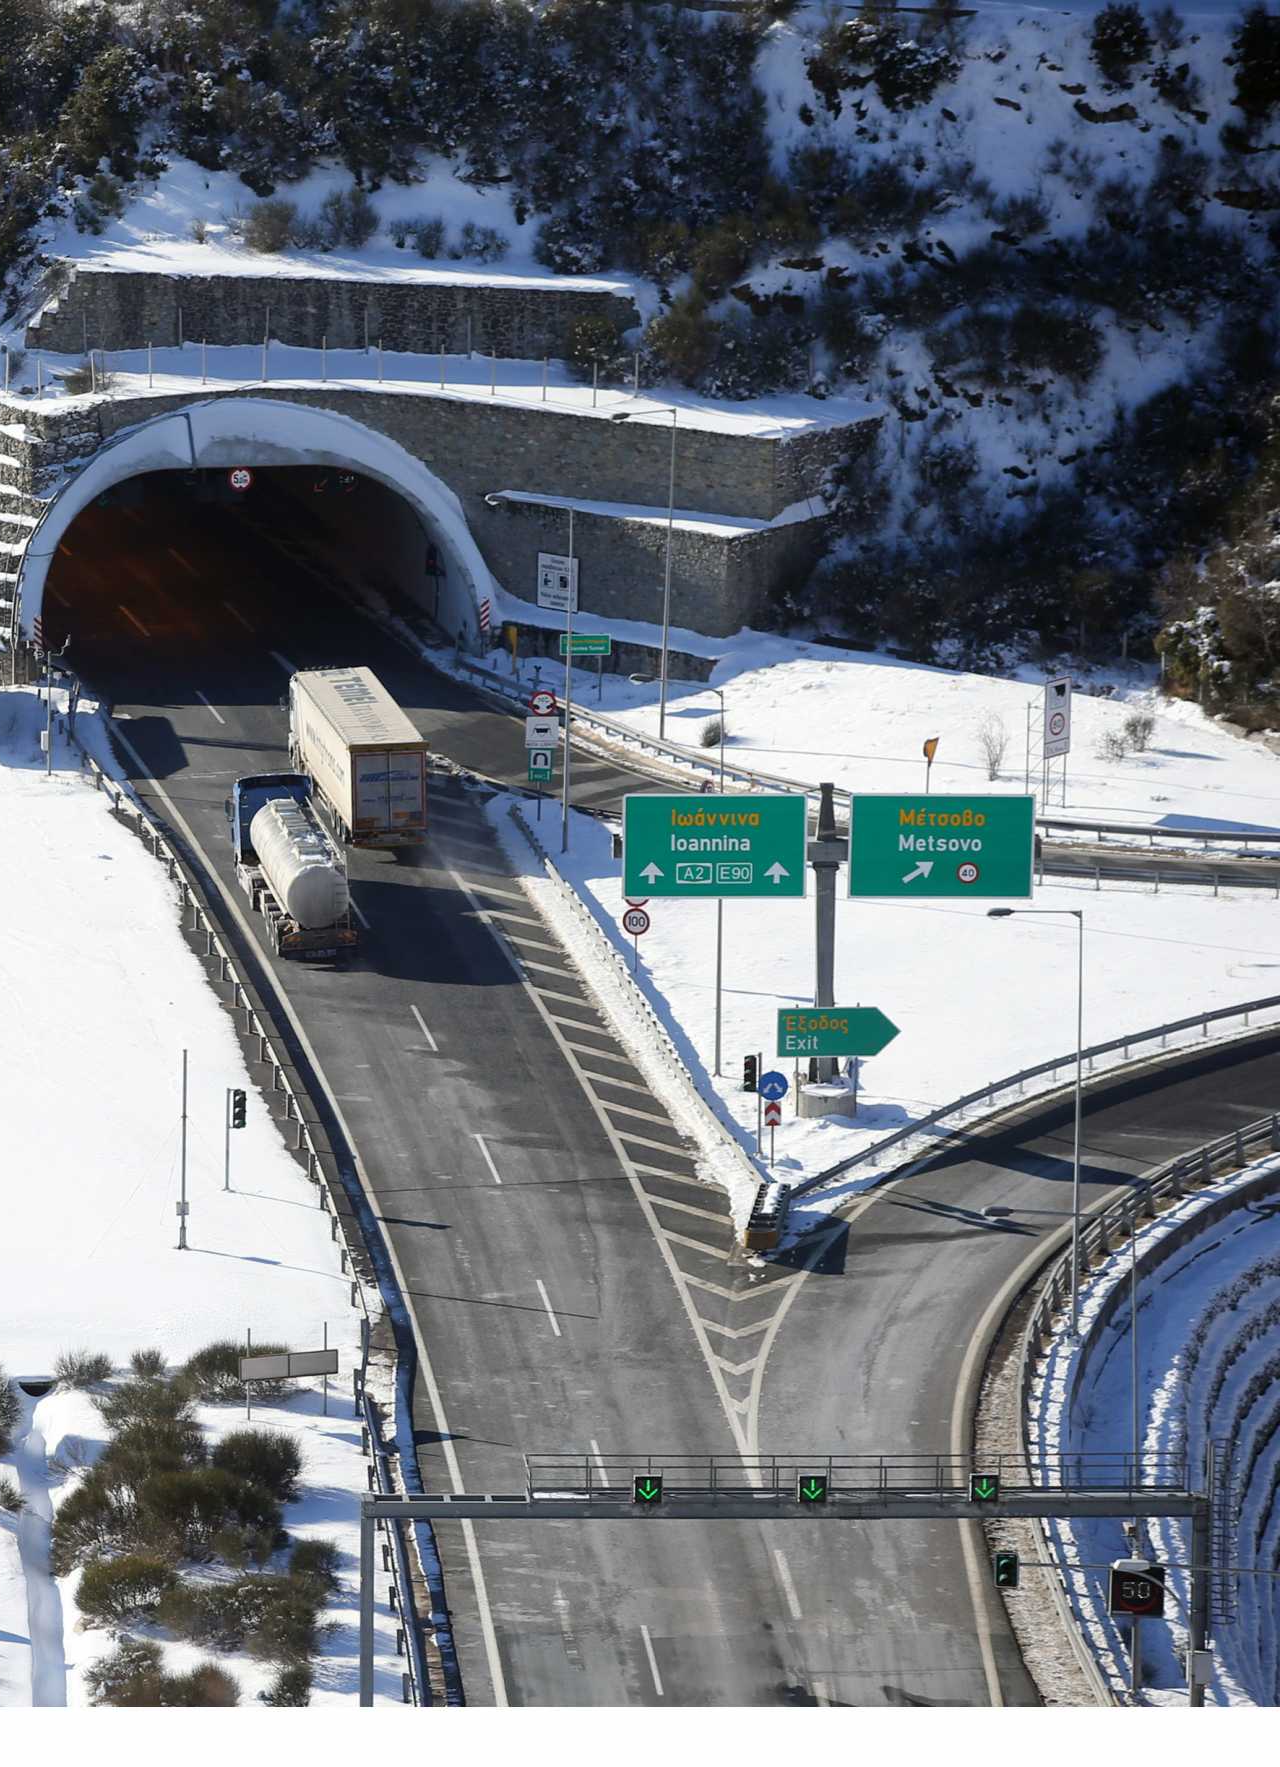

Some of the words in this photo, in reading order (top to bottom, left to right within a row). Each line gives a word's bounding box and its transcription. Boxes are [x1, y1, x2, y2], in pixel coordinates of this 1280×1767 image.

[671, 808, 760, 826] Ιωάννινα
[899, 808, 985, 826] Μέτσοβο
[671, 834, 751, 852] Ioannina
[899, 834, 983, 852] Metsovo
[683, 866, 705, 881] A2
[719, 866, 750, 881] E90
[961, 867, 975, 879] 40
[628, 915, 646, 927] 100
[782, 1014, 849, 1035] Έξοδος
[785, 1035, 818, 1050] Exit
[1122, 1581, 1151, 1600] 50
